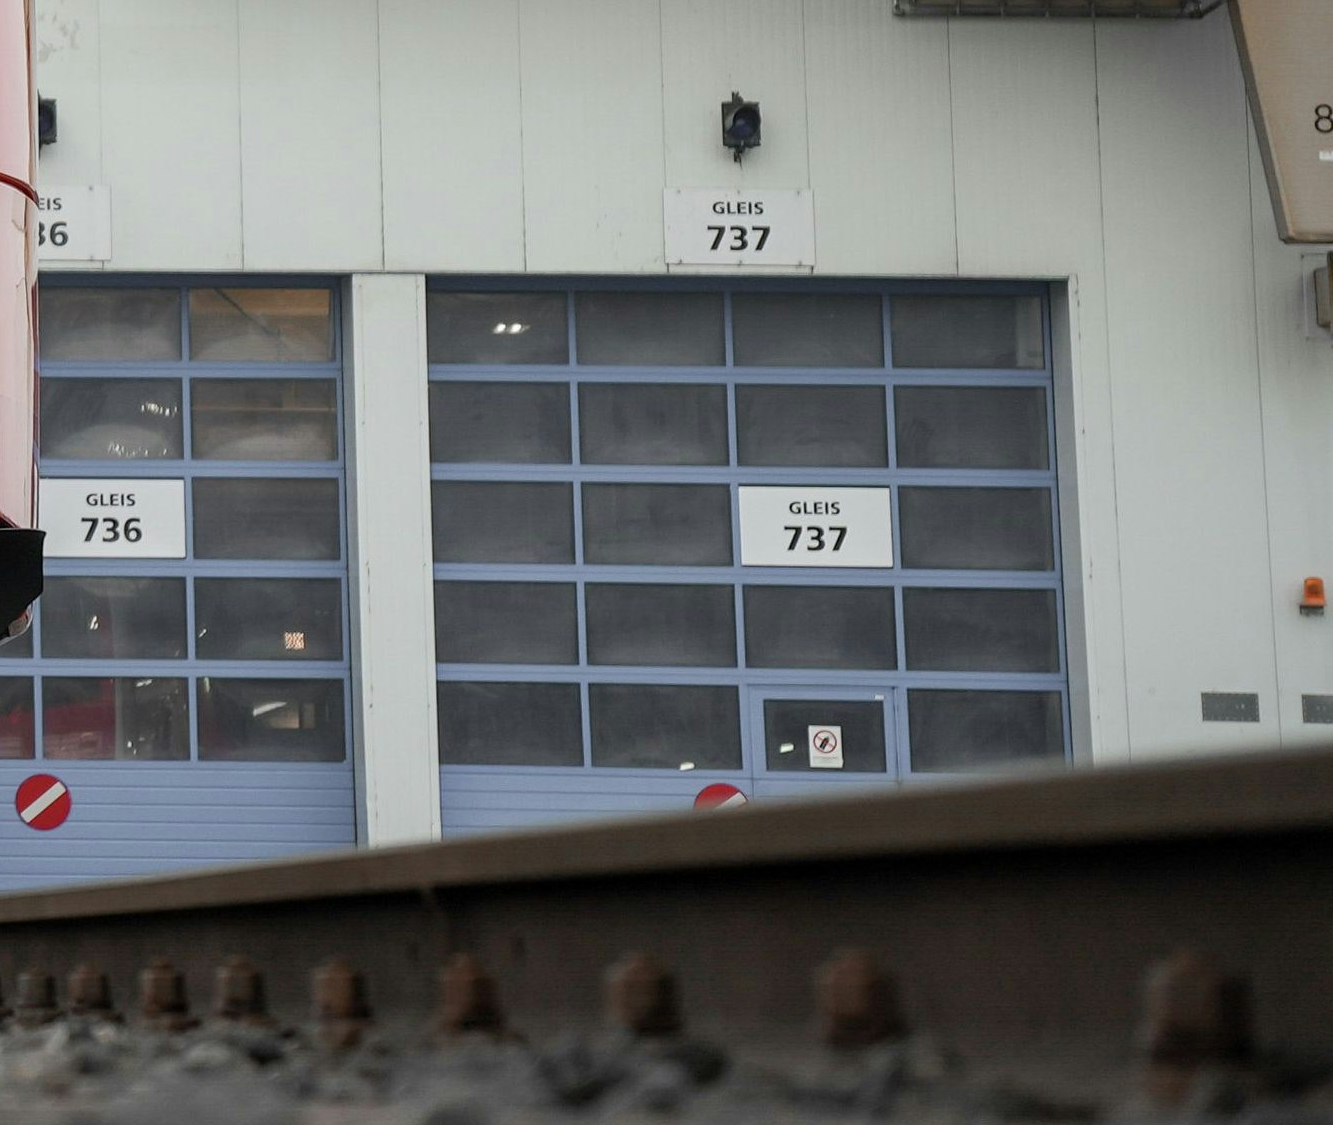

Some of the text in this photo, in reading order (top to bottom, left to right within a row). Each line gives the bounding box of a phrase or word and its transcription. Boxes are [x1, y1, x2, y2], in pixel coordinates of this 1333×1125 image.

[1314, 103, 1333, 134] 8
[712, 201, 764, 215] GLEIS
[706, 225, 771, 252] 737
[85, 493, 136, 507] GLEIS
[788, 501, 841, 515] GLEIS
[80, 517, 143, 543] 736
[783, 525, 847, 552] 737
